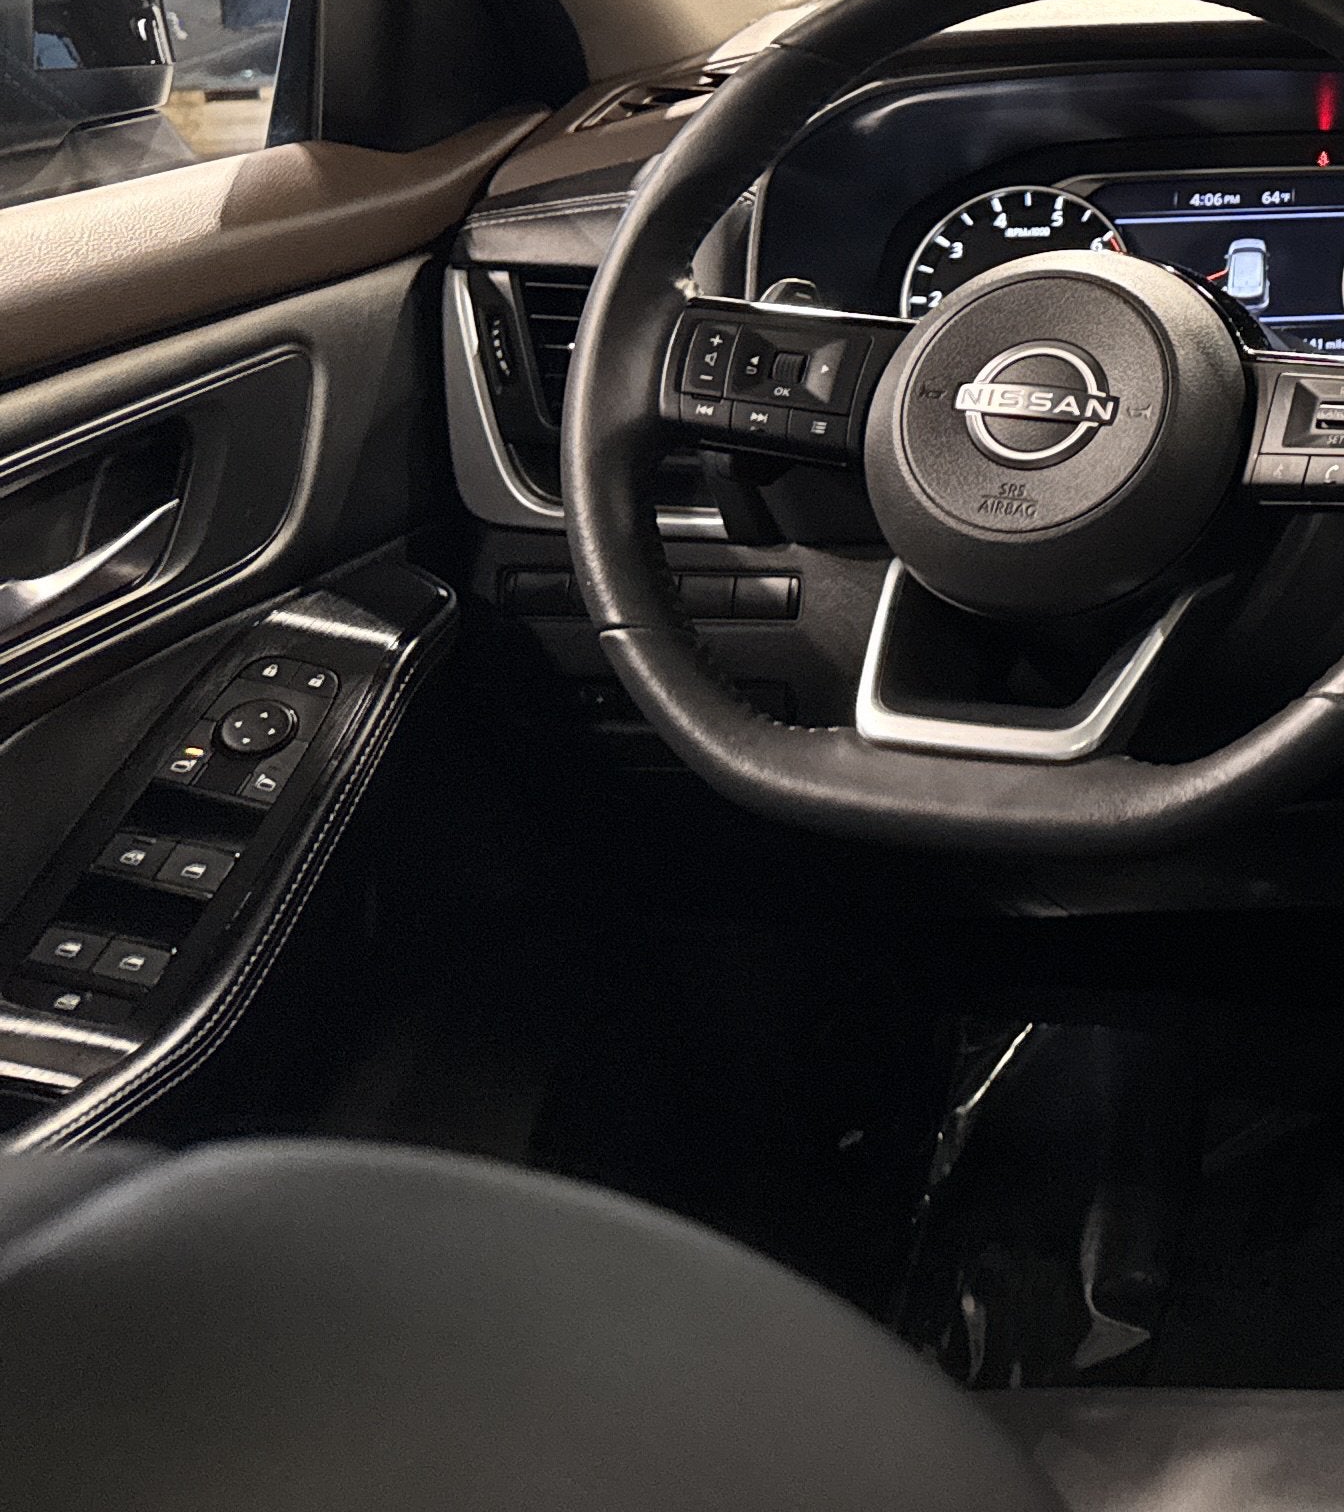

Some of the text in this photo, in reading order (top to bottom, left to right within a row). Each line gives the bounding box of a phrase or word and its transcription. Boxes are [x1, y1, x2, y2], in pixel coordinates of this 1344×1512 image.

[1189, 193, 1241, 207] 4:06 PM
[993, 212, 1008, 229] 4
[1051, 210, 1064, 227] 5
[949, 241, 964, 259] 3
[1090, 237, 1103, 251] 6
[928, 290, 943, 308] 2
[773, 386, 791, 398] OK
[960, 387, 1114, 421] NISSAN
[999, 483, 1026, 497] SRS
[977, 499, 1037, 517] AIRBAG
